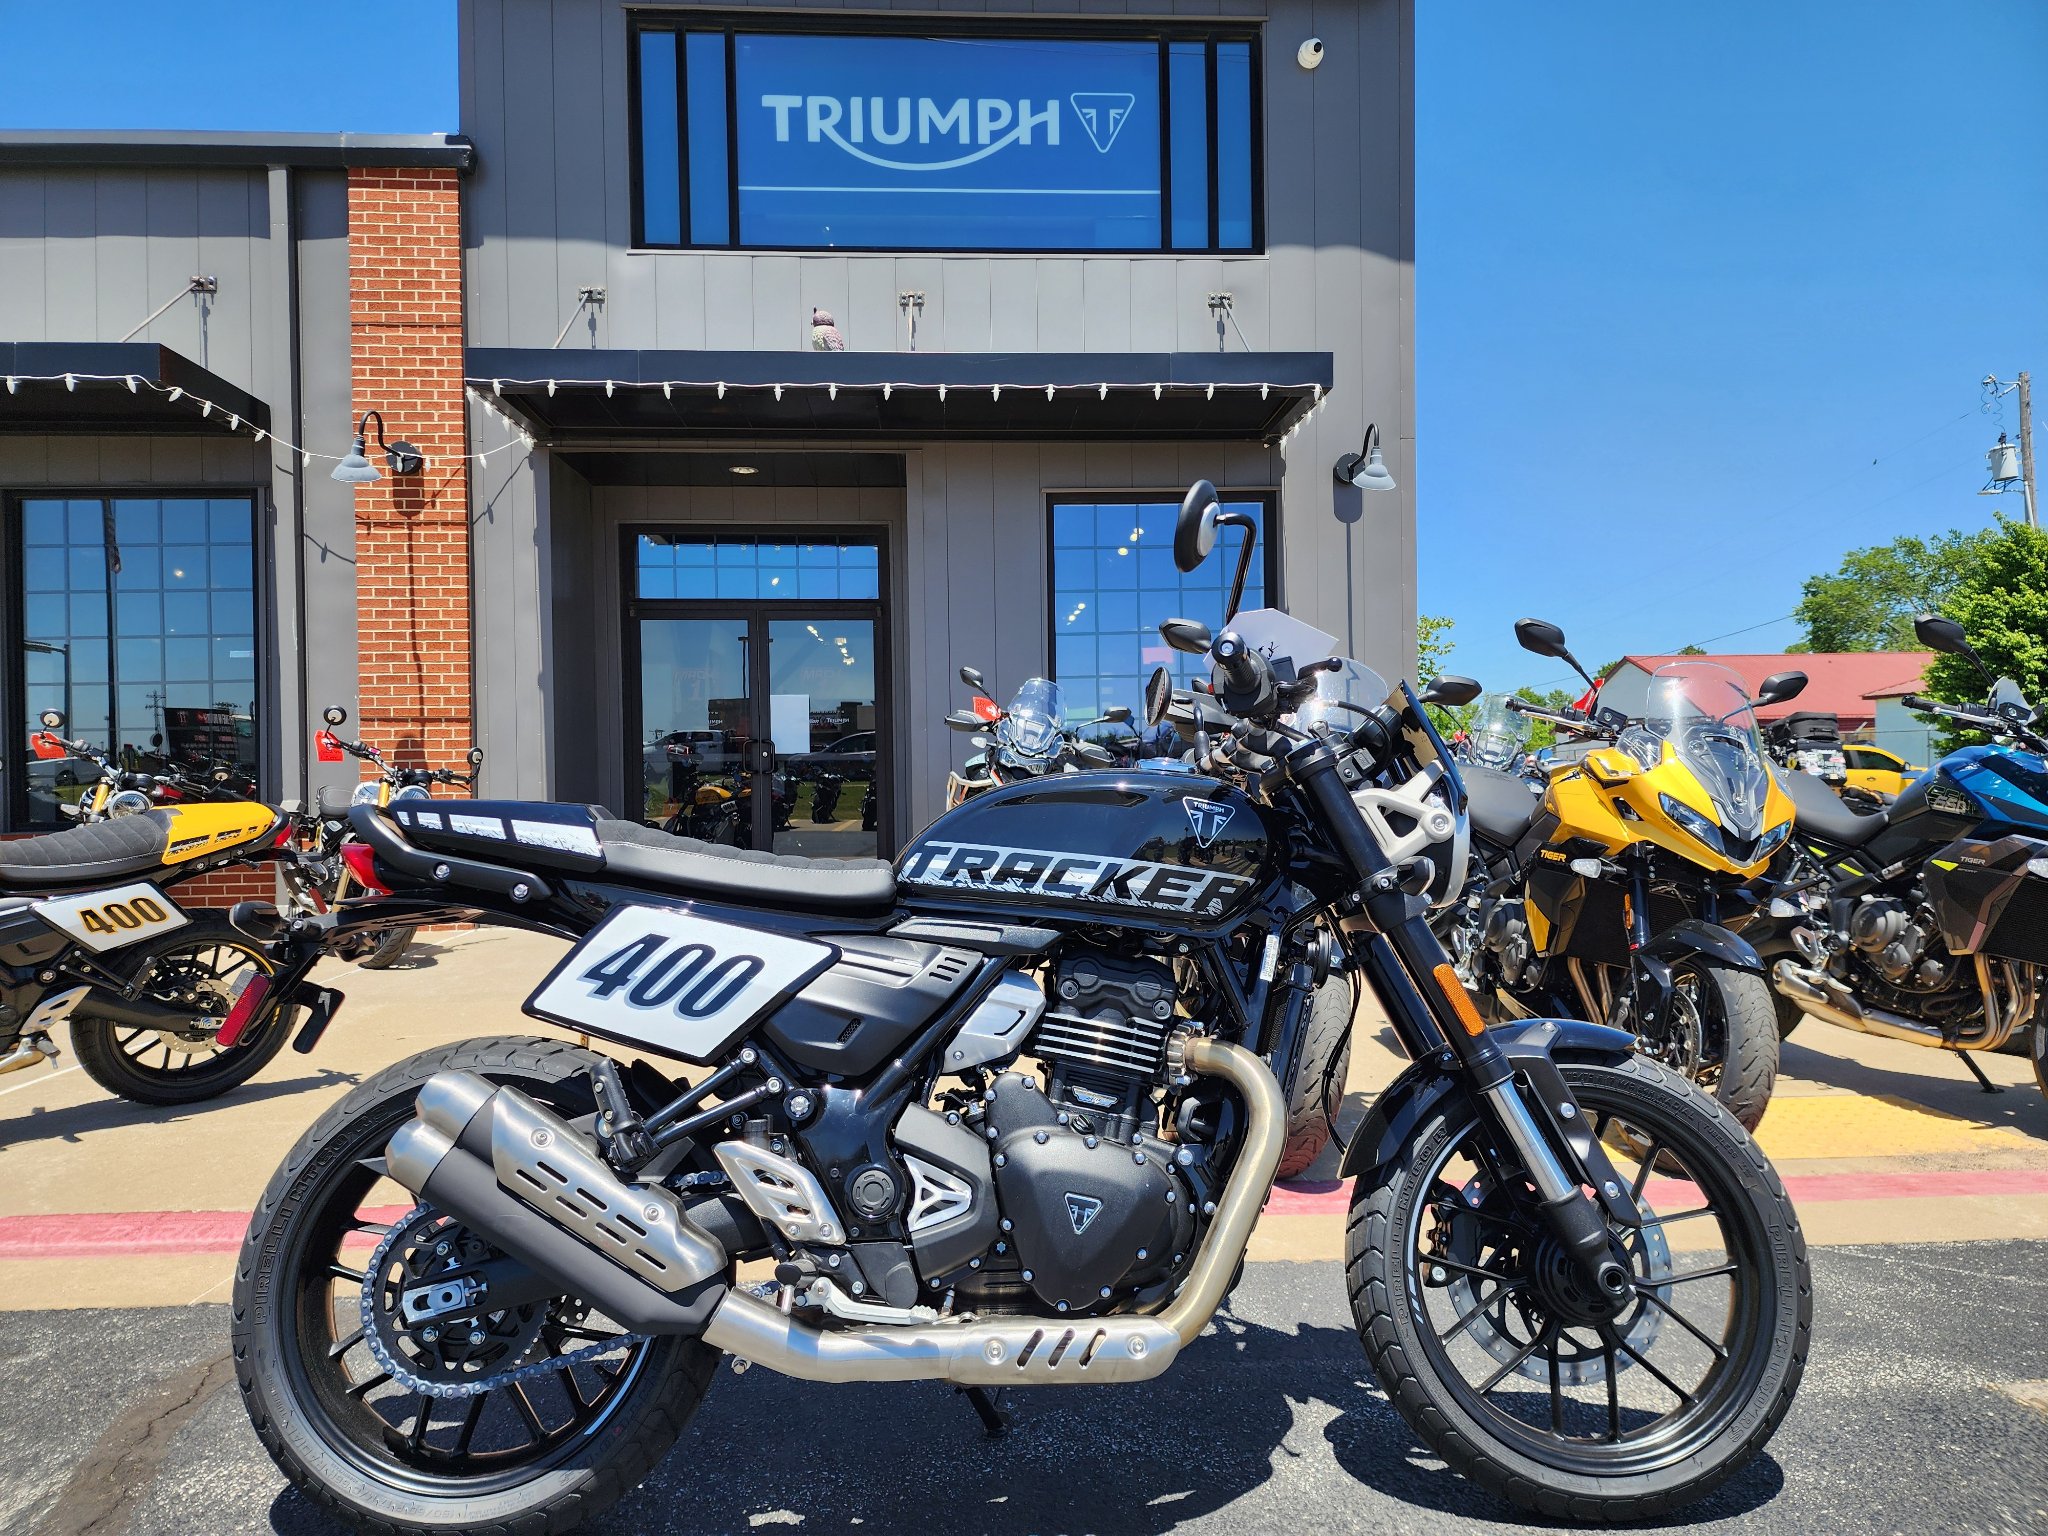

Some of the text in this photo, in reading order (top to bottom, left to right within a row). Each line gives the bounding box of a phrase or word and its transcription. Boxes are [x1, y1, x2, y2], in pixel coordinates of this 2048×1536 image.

[762, 95, 1059, 171] TRIUMPH
[1193, 801, 1225, 814] TRIUMPH
[905, 844, 1252, 915] TRACKER
[1540, 849, 1567, 863] TIGER
[1960, 856, 1986, 866] TIGER
[78, 897, 169, 934] 400
[578, 933, 766, 1021] 400
[254, 1207, 293, 1326] PIRELLI
